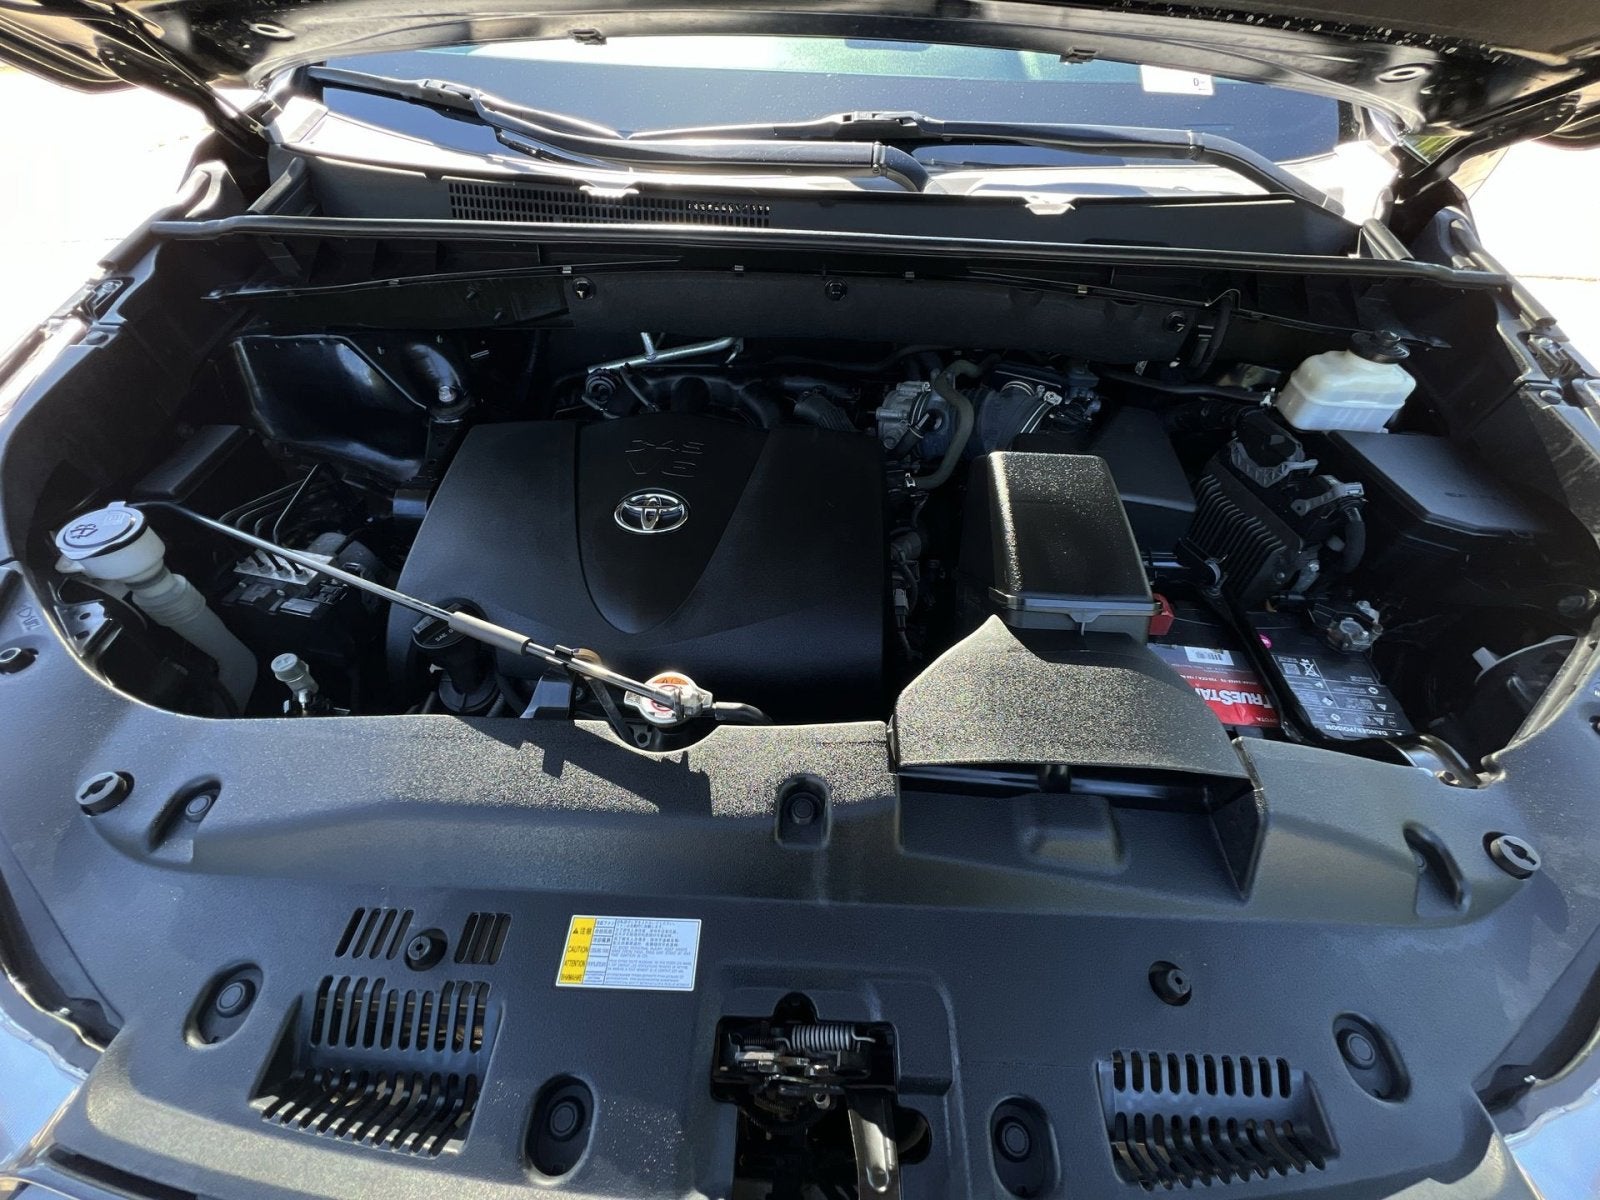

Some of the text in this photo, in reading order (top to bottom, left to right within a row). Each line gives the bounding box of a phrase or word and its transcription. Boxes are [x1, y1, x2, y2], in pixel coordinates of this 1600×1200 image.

[1325, 724, 1389, 736] DANGER/POISON
[567, 945, 589, 954] CAUTION
[564, 959, 586, 968] ATTENTION
